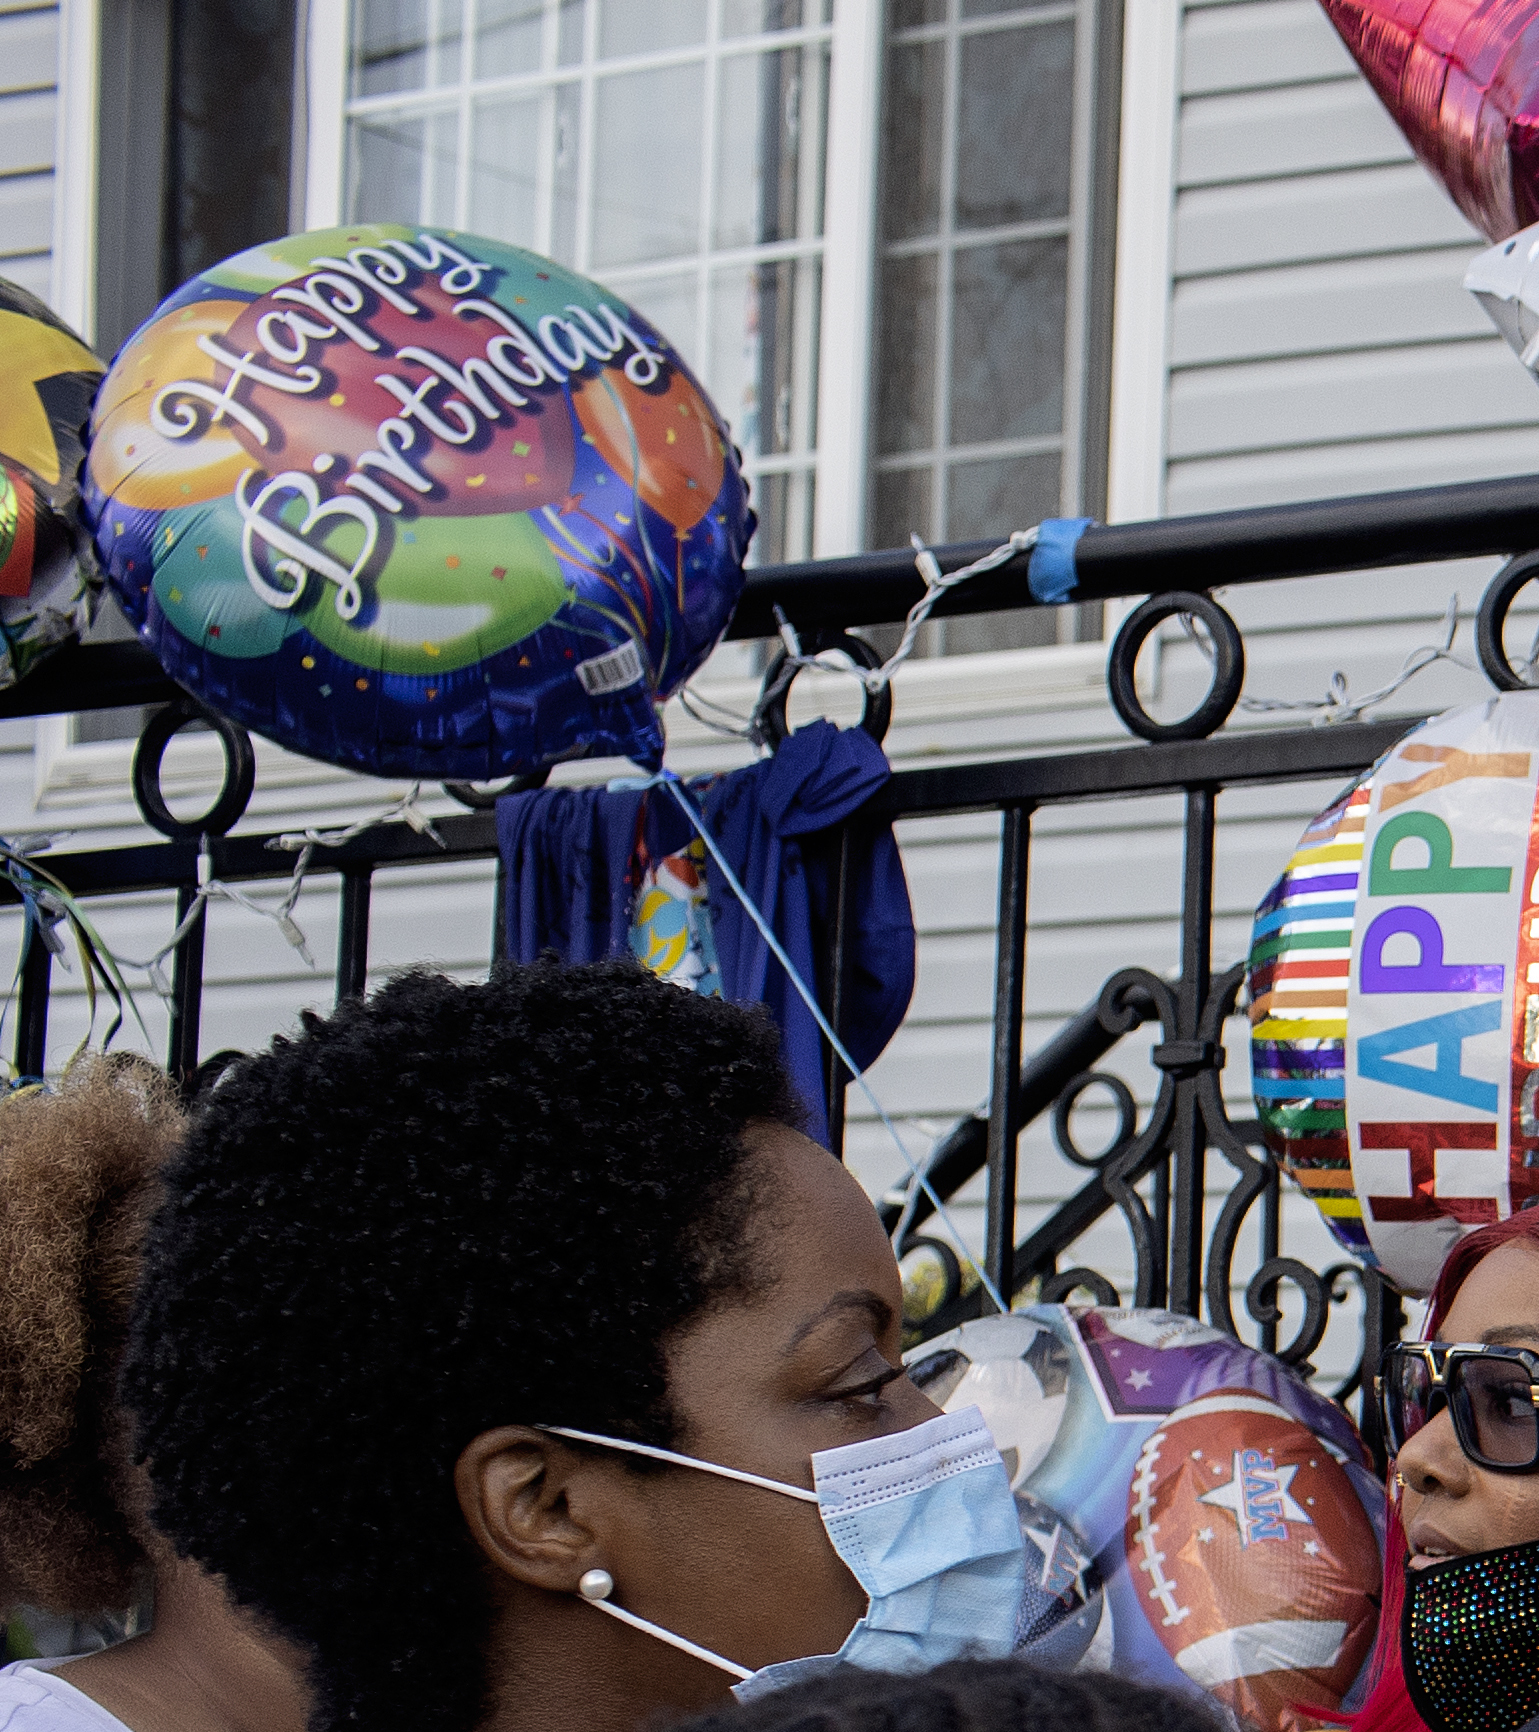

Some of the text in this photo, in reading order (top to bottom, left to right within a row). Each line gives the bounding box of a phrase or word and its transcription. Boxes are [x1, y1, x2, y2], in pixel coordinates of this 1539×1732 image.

[150, 232, 491, 447] Happy
[240, 298, 666, 621] Birthday
[1356, 743, 1532, 1225] HAPPY
[1241, 1448, 1290, 1544] MVP
